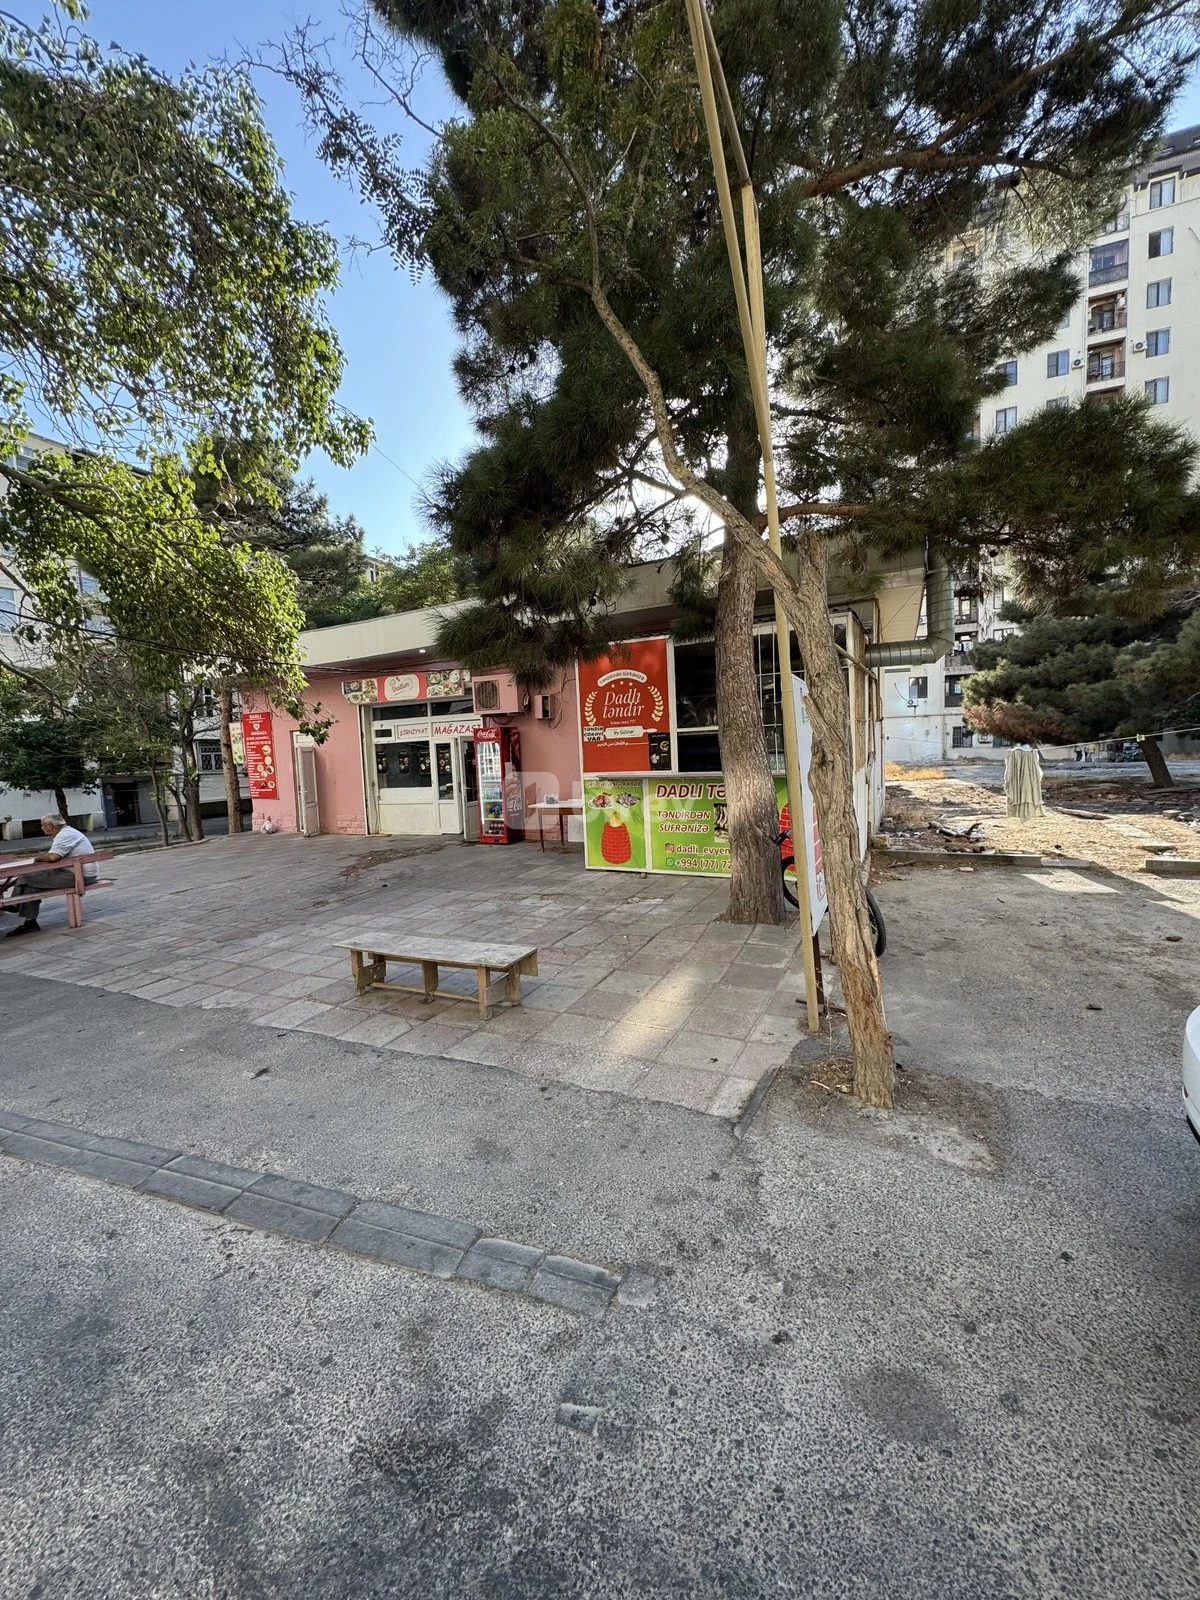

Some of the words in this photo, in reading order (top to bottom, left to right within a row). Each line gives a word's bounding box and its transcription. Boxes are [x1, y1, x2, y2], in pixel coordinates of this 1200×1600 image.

[603, 702, 645, 718] təndir
[656, 784, 703, 798] DADLI
[708, 784, 726, 798] TƏ
[657, 810, 711, 819] TƏNDİRDƏN
[659, 823, 709, 833] SÜFRƏNİZƏ
[676, 844, 731, 856] dadli_evyen
[675, 858, 698, 868] +994
[700, 859, 719, 870] (77)
[721, 861, 732, 870] 72
